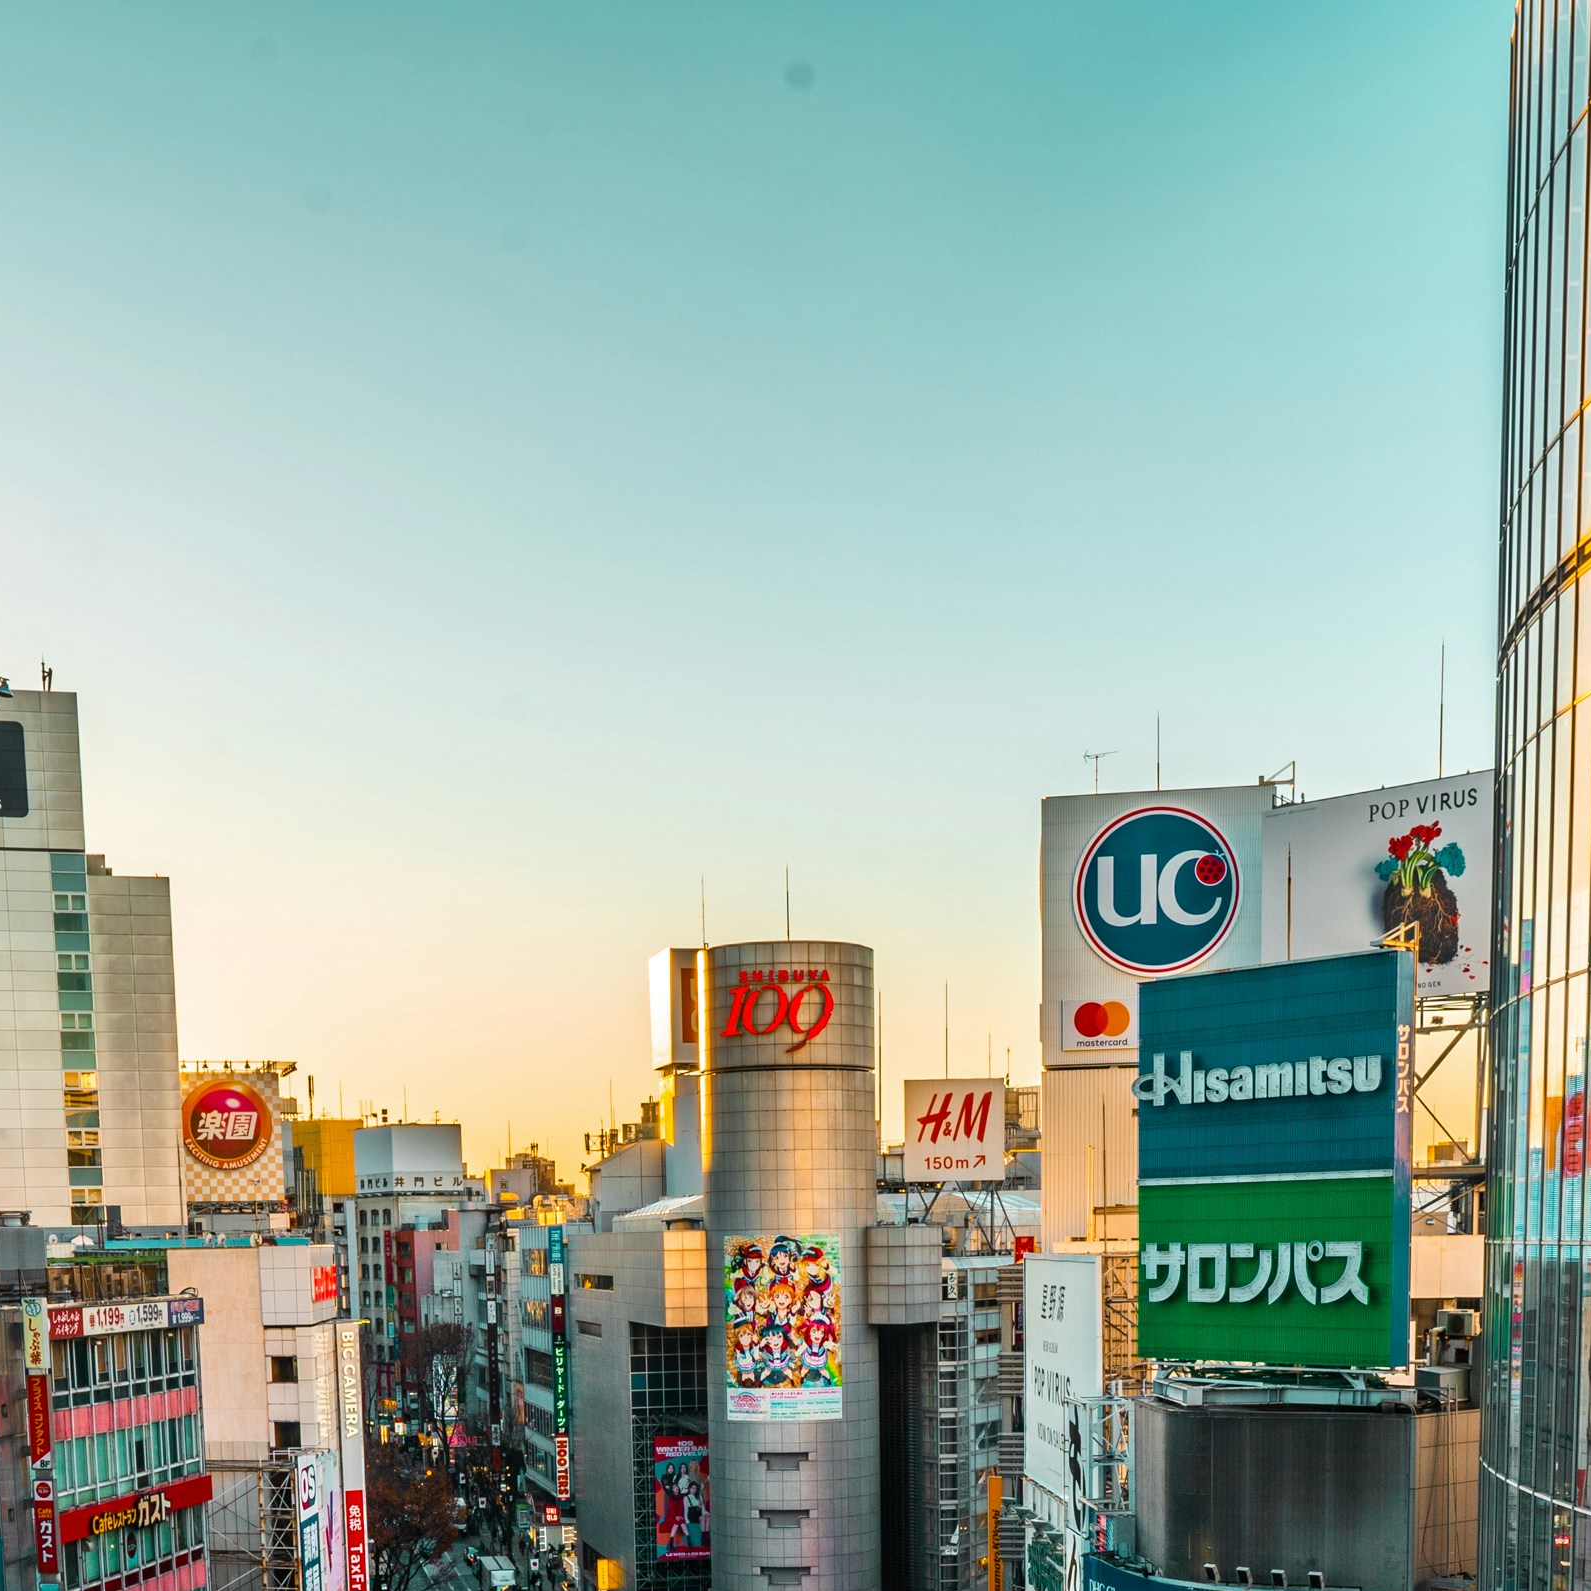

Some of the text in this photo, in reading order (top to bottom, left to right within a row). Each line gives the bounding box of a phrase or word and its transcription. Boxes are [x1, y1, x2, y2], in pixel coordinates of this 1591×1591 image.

[1368, 788, 1478, 823] POP VIRUS
[739, 969, 830, 982] SHIBUYA
[720, 982, 835, 1053] 109
[1077, 1038, 1128, 1048] mastercard
[1132, 1051, 1381, 1107] Hisamitsu
[1396, 1024, 1411, 1114] サロンパス
[196, 1109, 258, 1140] 楽園
[917, 1091, 992, 1144] H&M
[185, 1138, 268, 1169] EXCITING AMUSEMENT
[925, 1156, 969, 1169] 150m
[394, 1176, 463, 1188] 井門ビル
[1141, 1241, 1368, 1306] サロンパス
[28, 1318, 42, 1365] しゃぶ葉
[341, 1331, 359, 1438] BIC CAMERA
[32, 1378, 45, 1455] プライス コンタクト
[557, 1440, 568, 1496] HOOTERS
[138, 1493, 171, 1527] ガスト
[349, 1505, 361, 1531] 免税
[40, 1520, 53, 1563] ガスト
